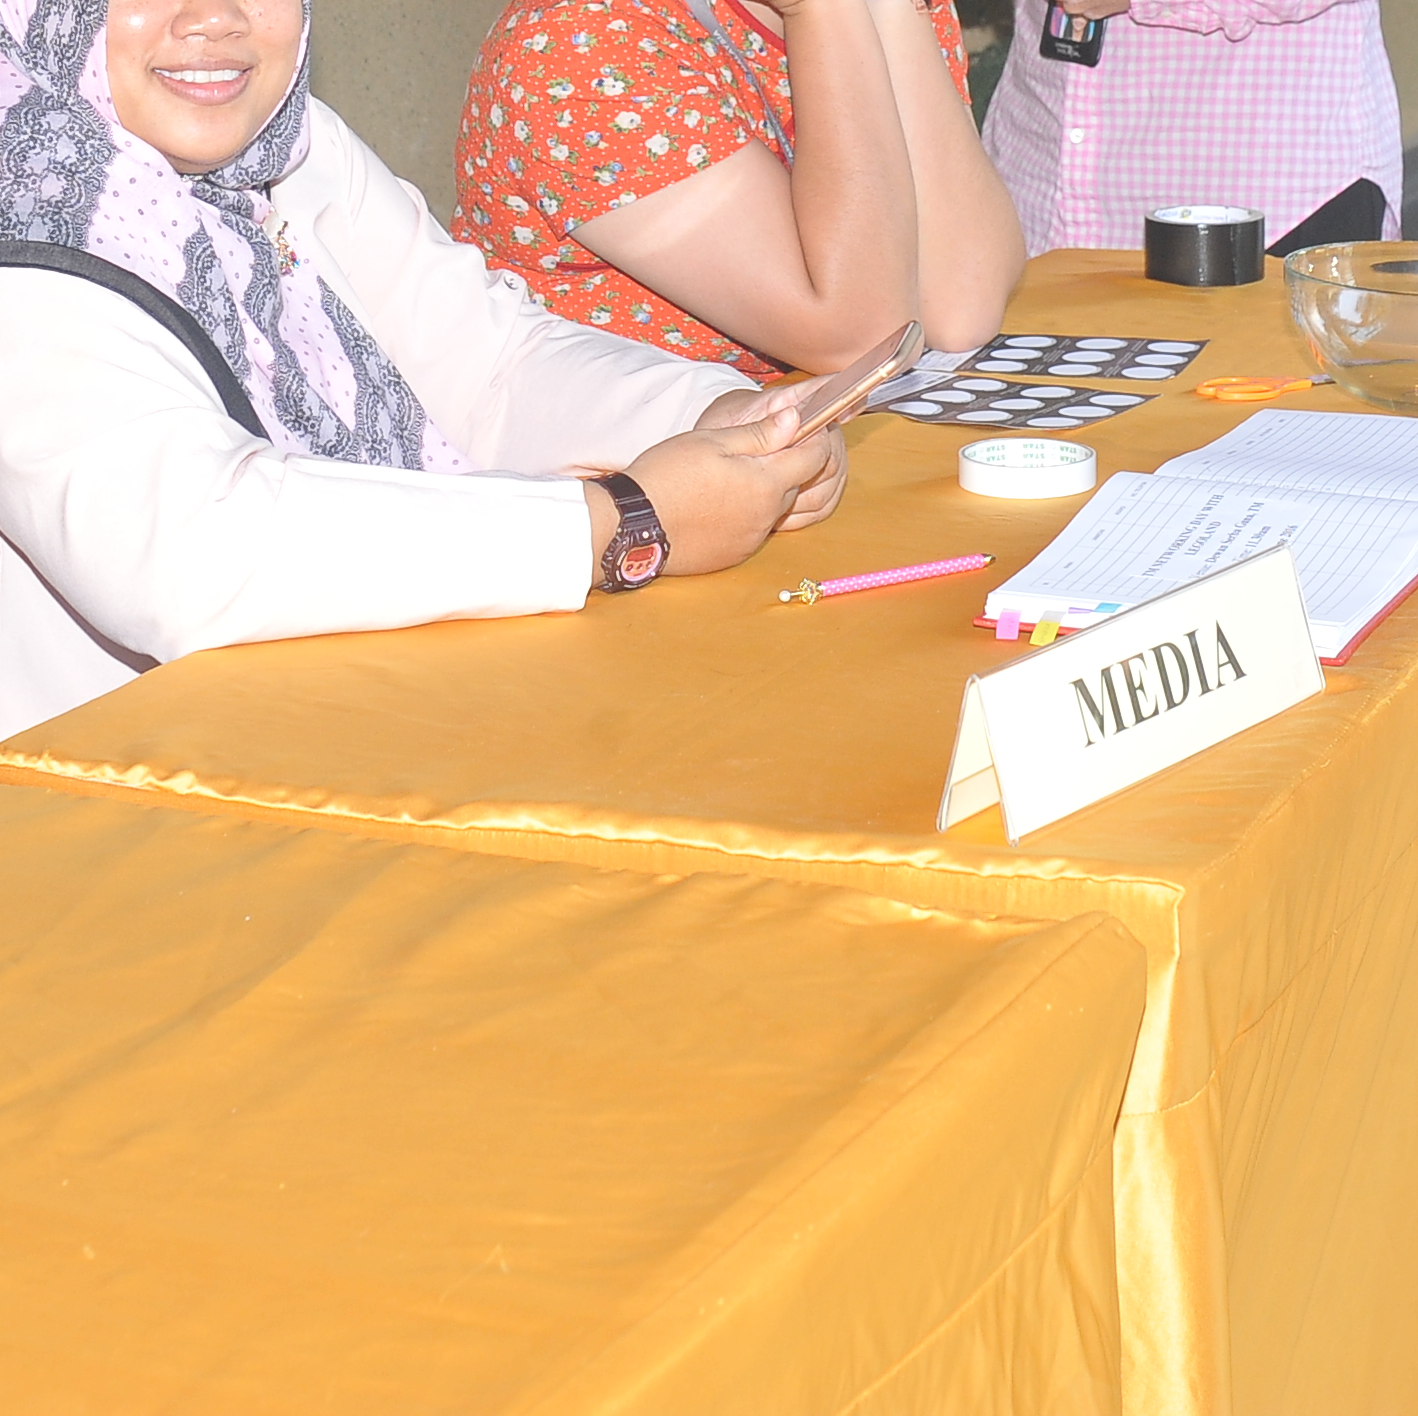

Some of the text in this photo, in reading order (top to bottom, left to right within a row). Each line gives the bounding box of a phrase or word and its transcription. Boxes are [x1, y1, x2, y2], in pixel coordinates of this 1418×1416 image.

[1151, 525, 1197, 568] NETWORKING
[1190, 513, 1209, 526] DAY
[1201, 494, 1224, 512] WITH
[1247, 502, 1265, 512] TM
[1184, 521, 1221, 555] LEGOLAND
[1069, 620, 1247, 748] MEDIA
